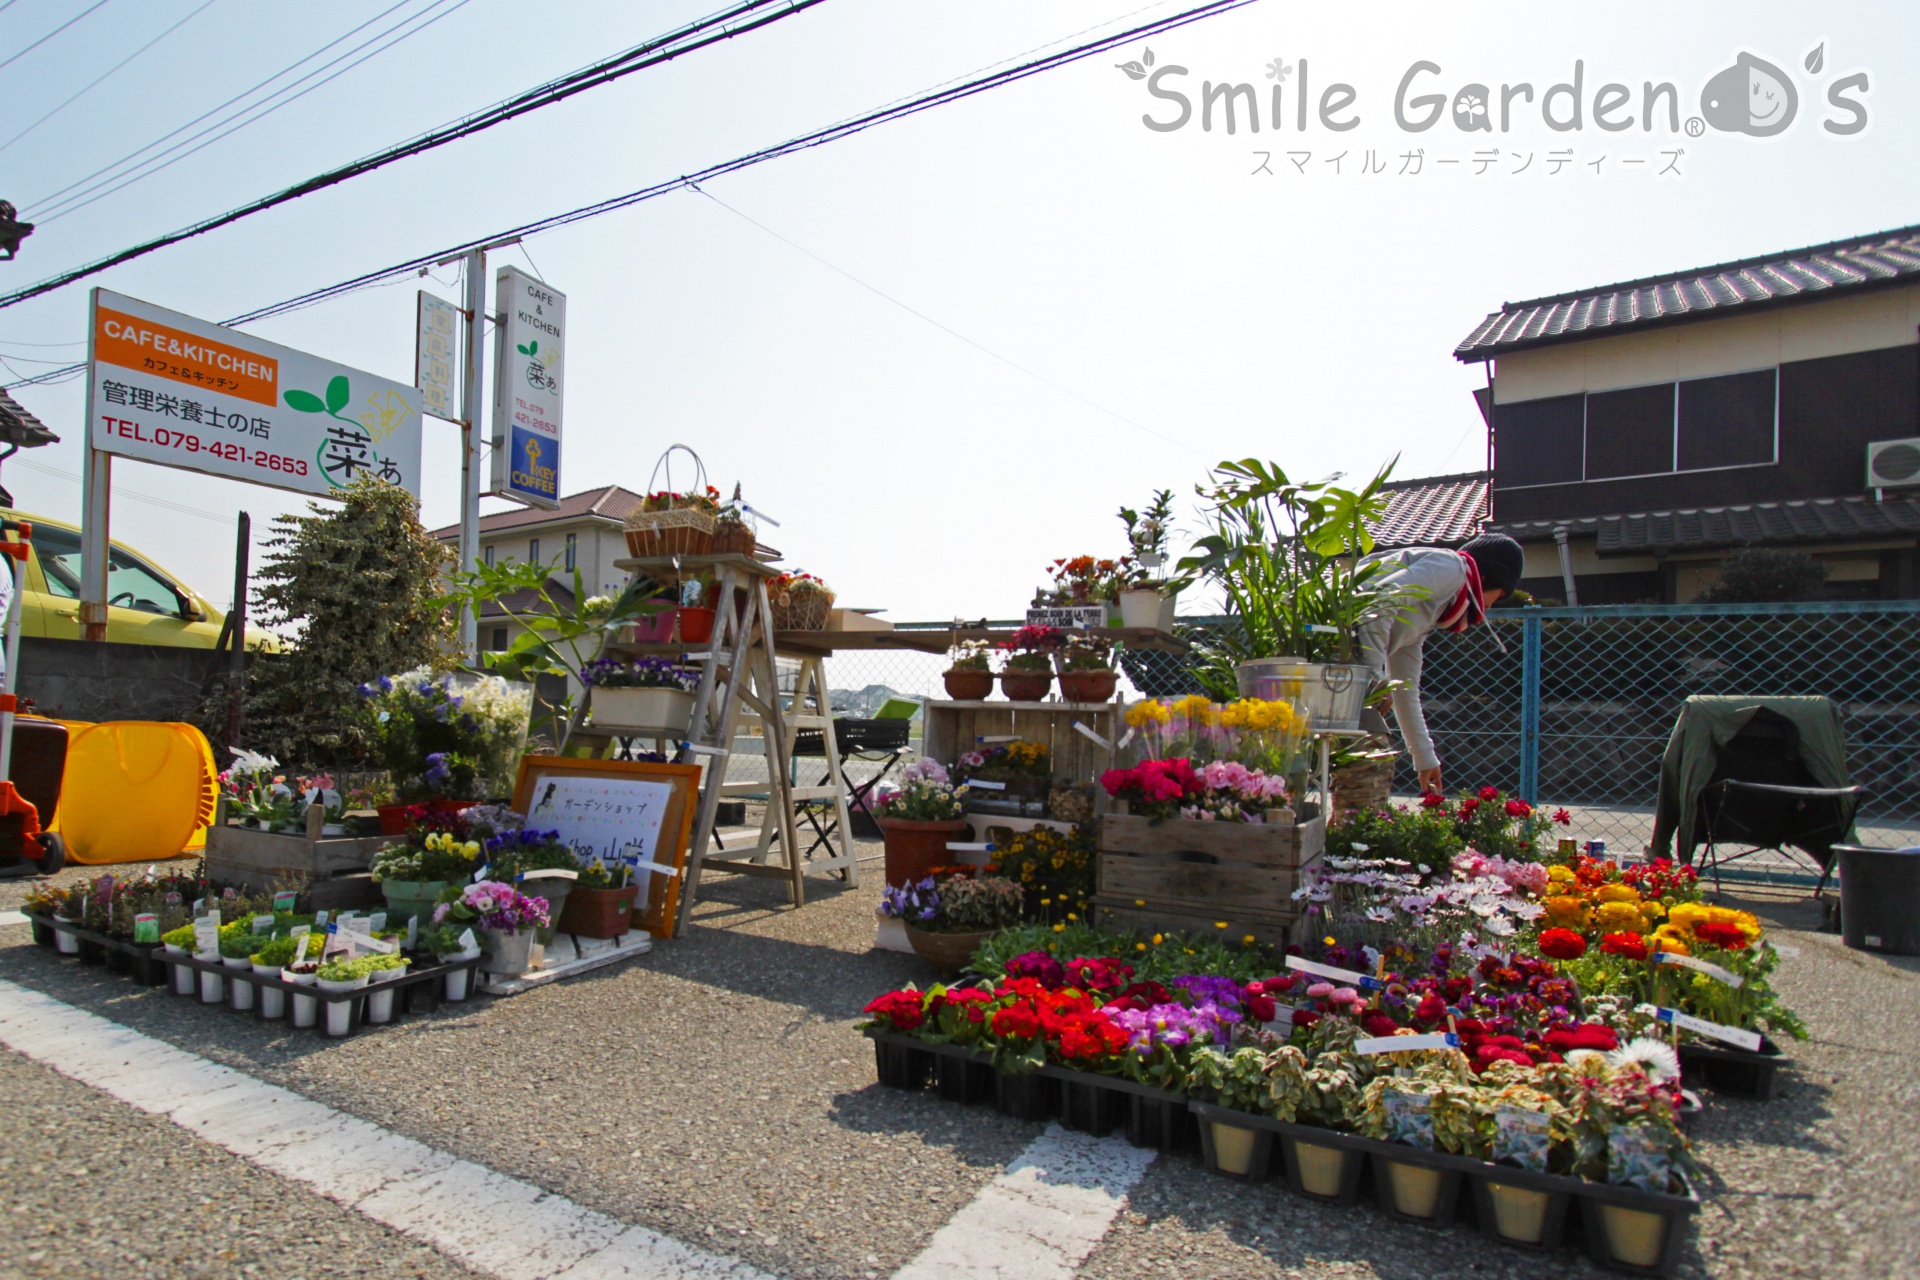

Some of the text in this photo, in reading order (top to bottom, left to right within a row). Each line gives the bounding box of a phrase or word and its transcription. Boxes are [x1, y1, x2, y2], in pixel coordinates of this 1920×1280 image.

[527, 286, 553, 306] CAFE
[535, 305, 543, 315] &
[518, 310, 560, 338] KITCHEN
[103, 320, 274, 383] CAFE&KITCHEN
[143, 357, 239, 391] カフェ&キッチン
[102, 378, 271, 440] 管理栄養士の店
[515, 397, 545, 416] TEL.079
[514, 412, 557, 434] 421-2653
[102, 415, 308, 476] TEL.079-421-2653
[512, 471, 555, 495] COFFEE
[536, 466, 556, 481] KEY
[564, 798, 648, 815] ガーデンショップ
